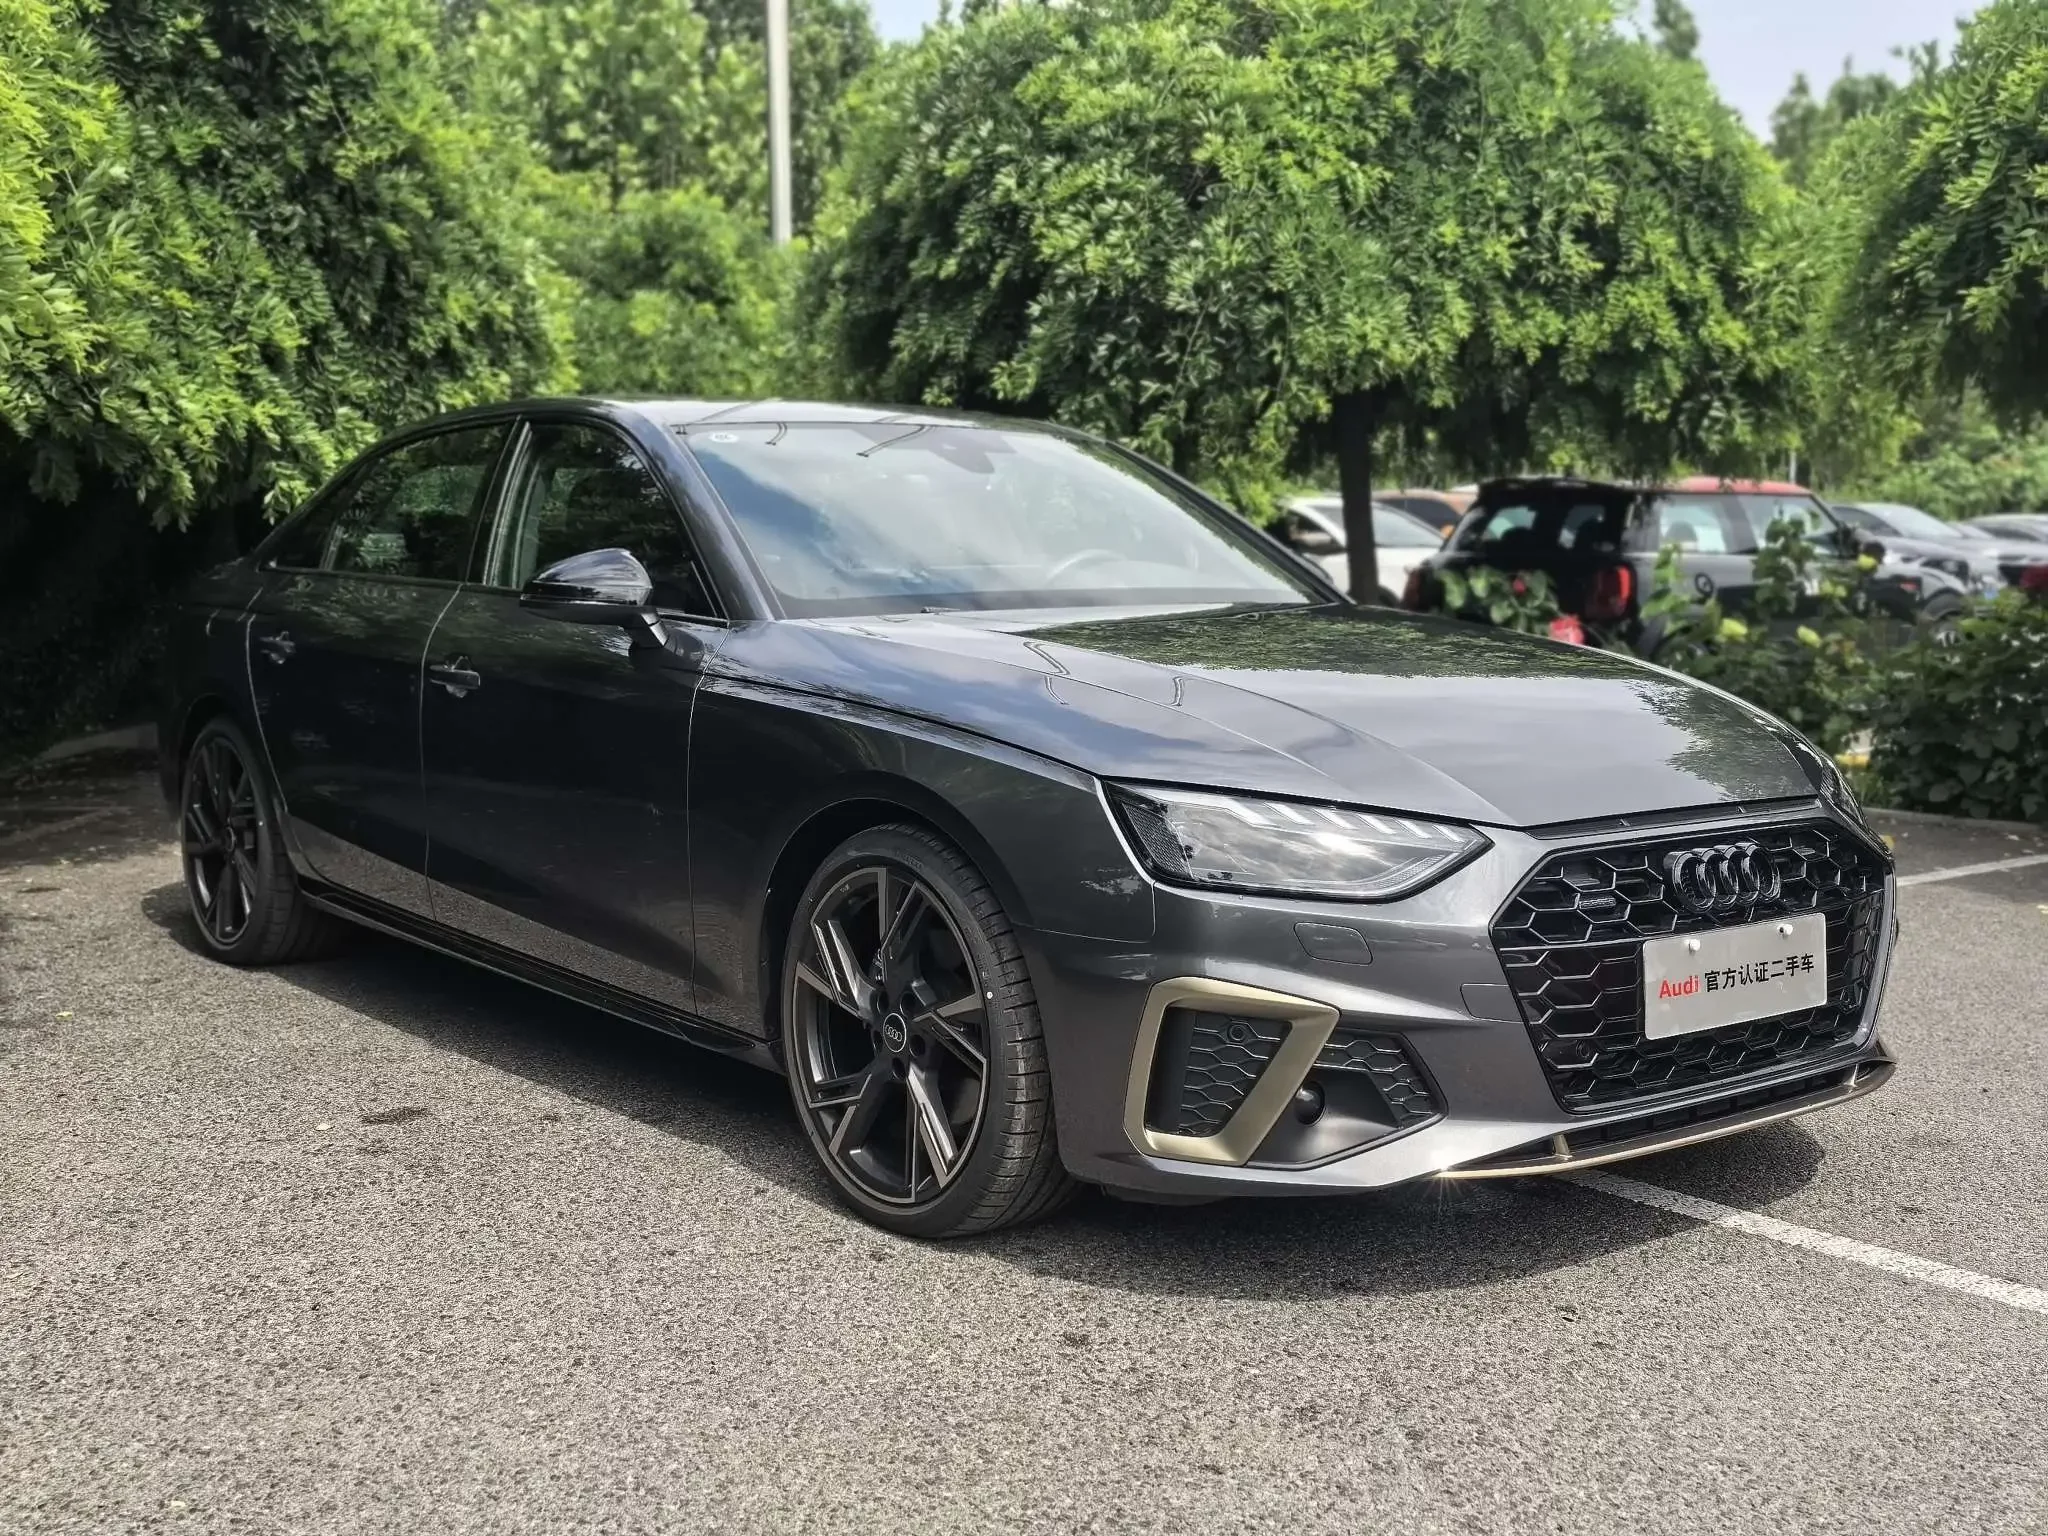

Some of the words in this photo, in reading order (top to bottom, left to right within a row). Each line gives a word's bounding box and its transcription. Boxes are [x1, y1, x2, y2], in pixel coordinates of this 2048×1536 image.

[1659, 974, 1700, 999] Audi
[1704, 953, 1815, 993] 官方认证二手车
